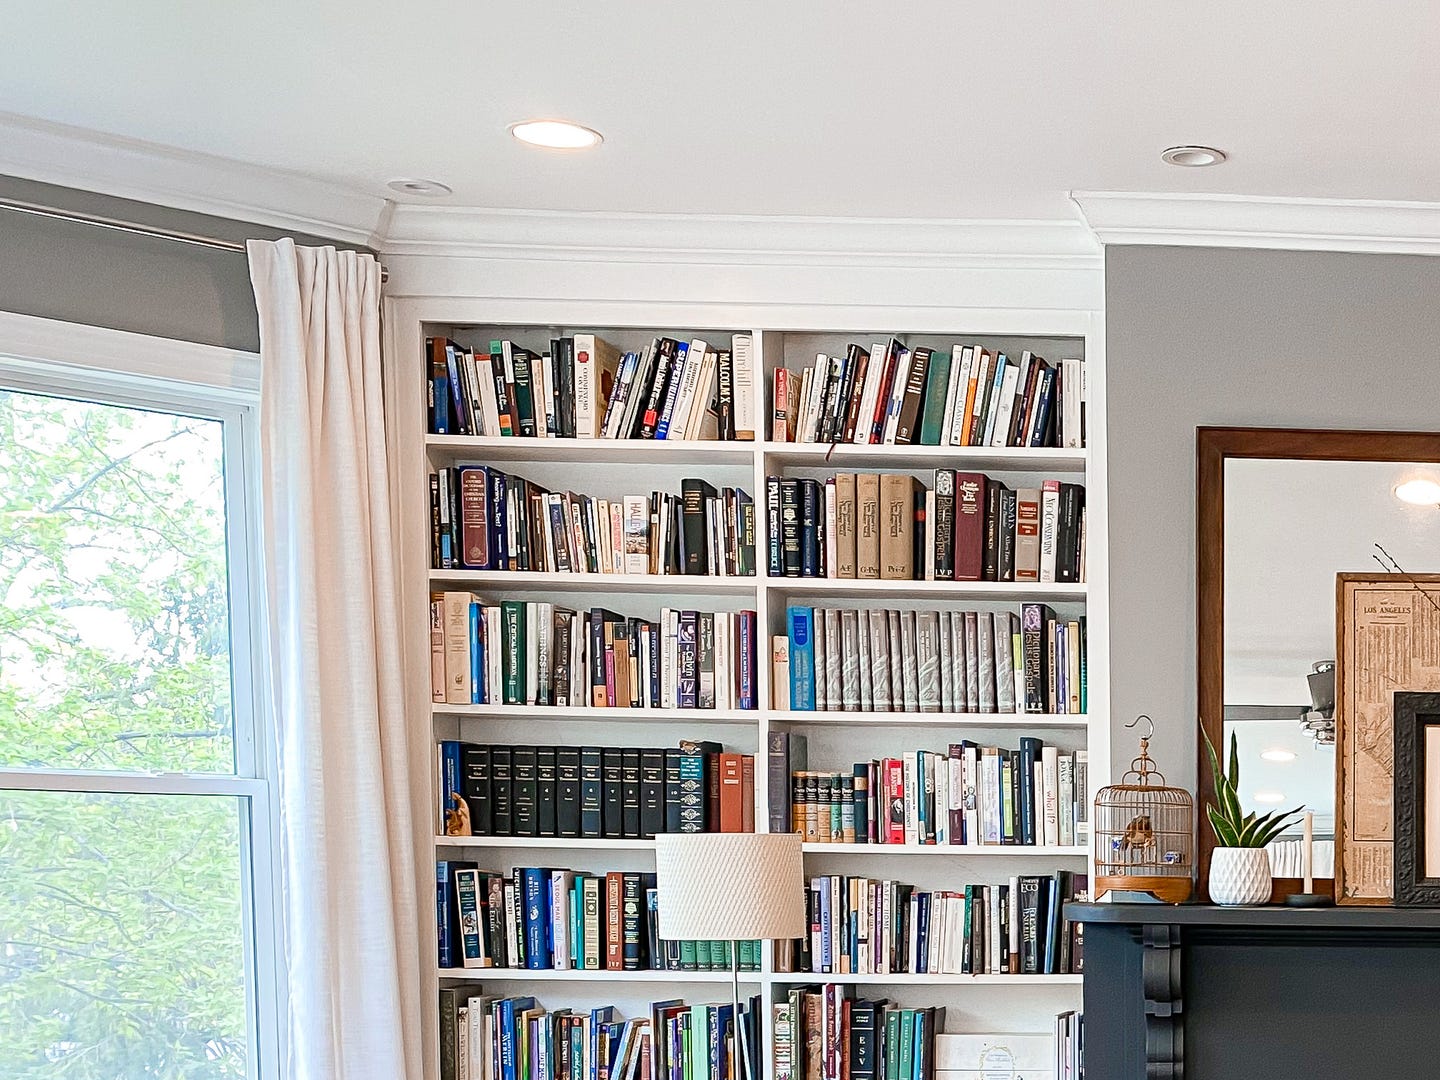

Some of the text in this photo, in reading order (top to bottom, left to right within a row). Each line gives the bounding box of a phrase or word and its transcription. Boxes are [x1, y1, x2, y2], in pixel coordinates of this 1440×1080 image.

[719, 353, 730, 403] MALCOLM X
[768, 481, 778, 509] PAUL
[935, 525, 945, 561] Gospels
[1363, 606, 1411, 614] LOS ANGELES
[685, 651, 695, 676] Calvin
[1025, 631, 1035, 694] Jesus Gospels
[1032, 631, 1041, 678] Dictionary
[890, 767, 899, 796] BRANSON
[1046, 790, 1055, 811] what
[1020, 882, 1039, 893] ECO
